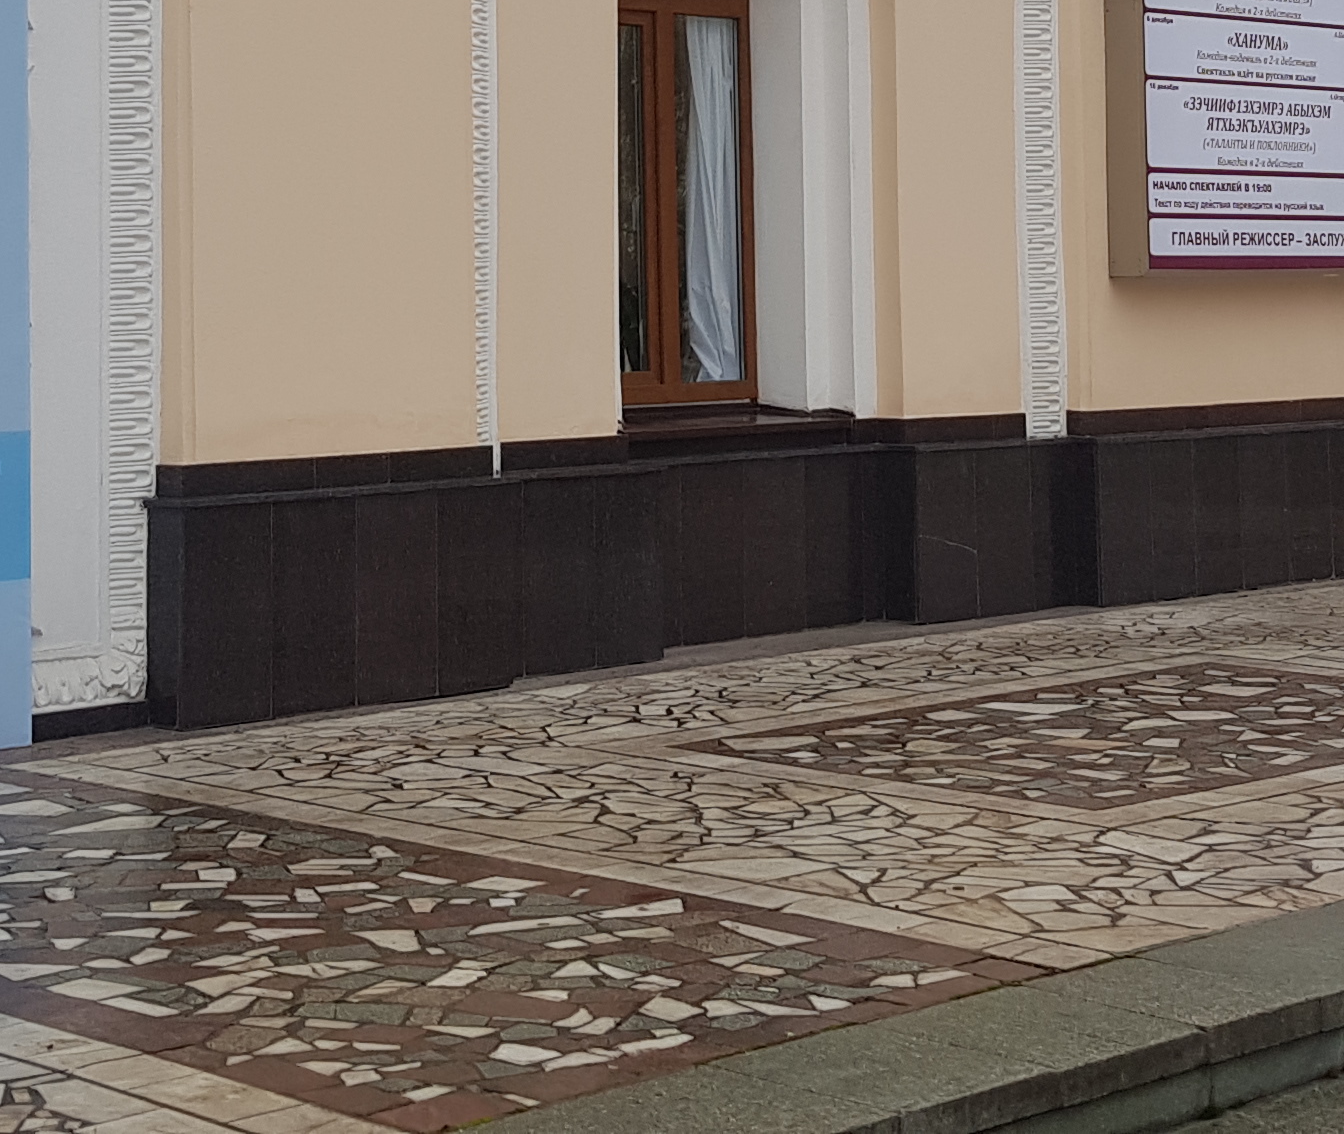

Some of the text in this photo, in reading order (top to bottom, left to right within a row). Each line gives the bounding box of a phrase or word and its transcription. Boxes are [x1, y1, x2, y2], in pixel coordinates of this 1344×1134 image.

[1216, 2, 1246, 14] Комедия
[1227, 32, 1289, 51] «ХАНУМА»
[1197, 65, 1235, 76] Спектакль
[1285, 103, 1331, 118] АБЫХЭМ
[1249, 140, 1255, 149] И
[1153, 181, 1187, 191] НАЧАЛО
[1189, 181, 1242, 192] СПЕКТАКЛЕЙ
[1244, 183, 1249, 192] В
[1154, 198, 1172, 207] Текст
[1283, 202, 1307, 212] русский
[1171, 229, 1230, 246] ГЛАВНЫЙ
[1233, 232, 1294, 246] РЕЖИССЕР
